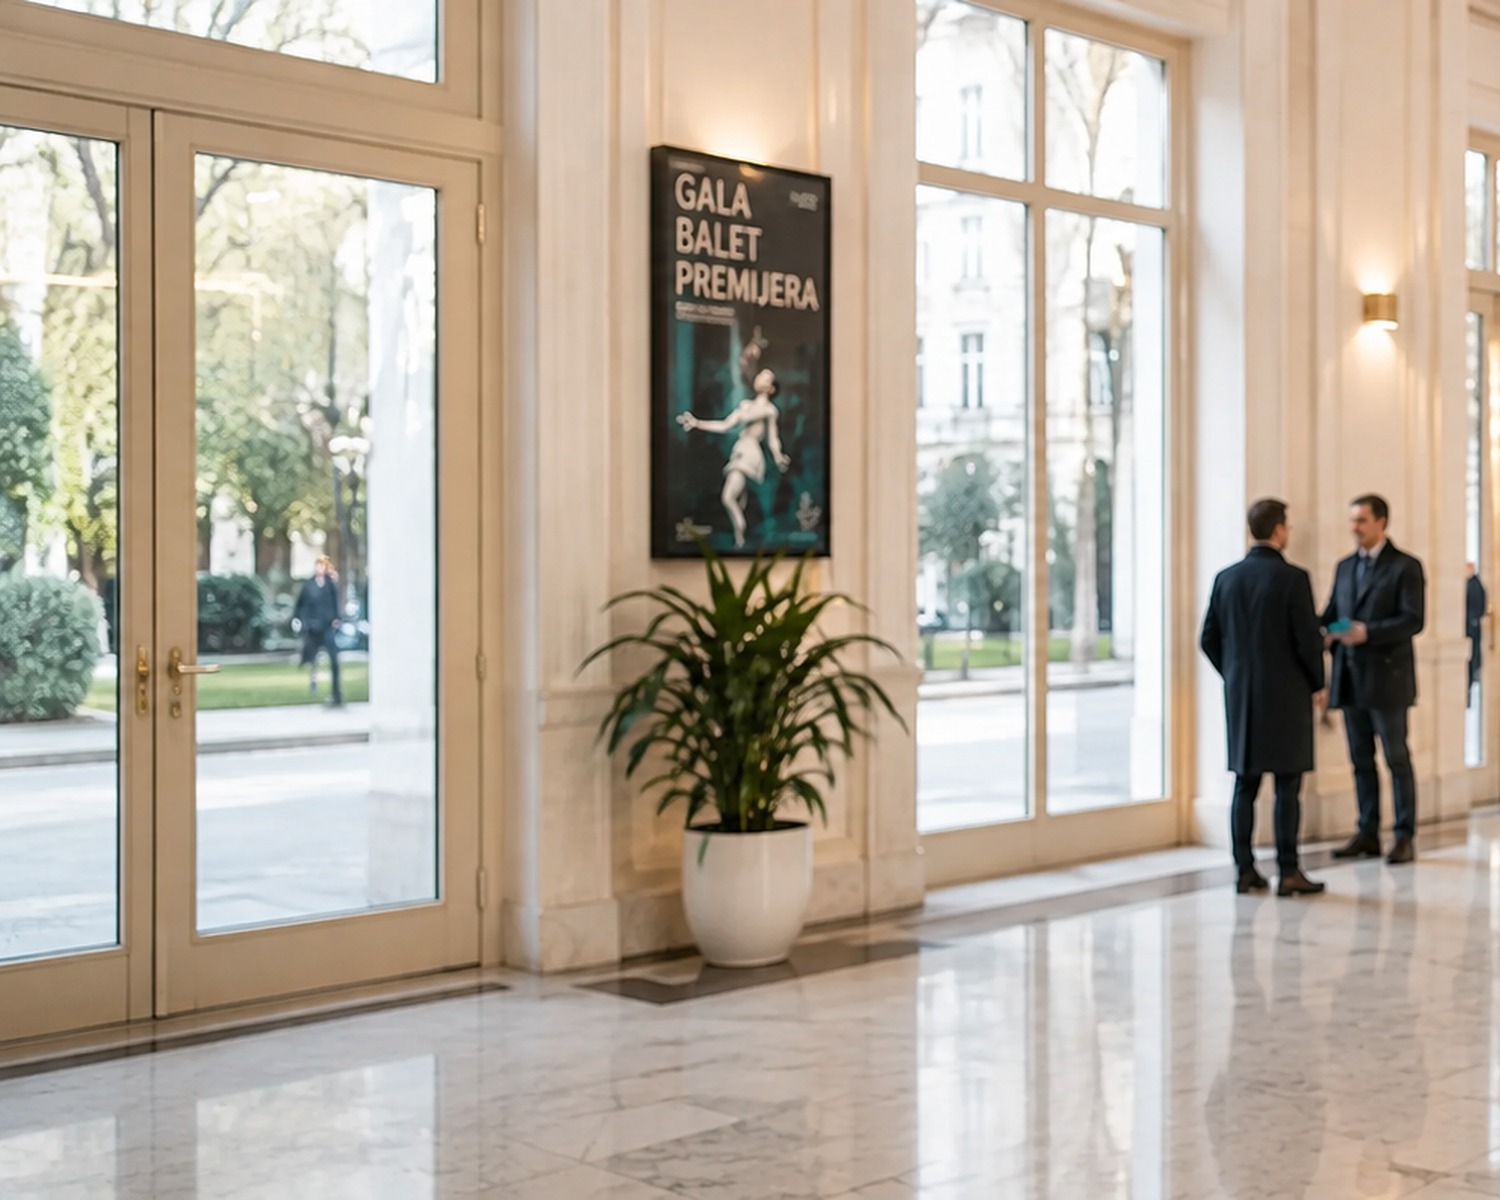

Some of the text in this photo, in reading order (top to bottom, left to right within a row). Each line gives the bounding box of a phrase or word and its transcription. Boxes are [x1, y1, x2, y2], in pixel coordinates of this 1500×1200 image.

[675, 173, 752, 219] GALA
[675, 216, 763, 262] BALET
[675, 260, 819, 312] PREMIJERA
